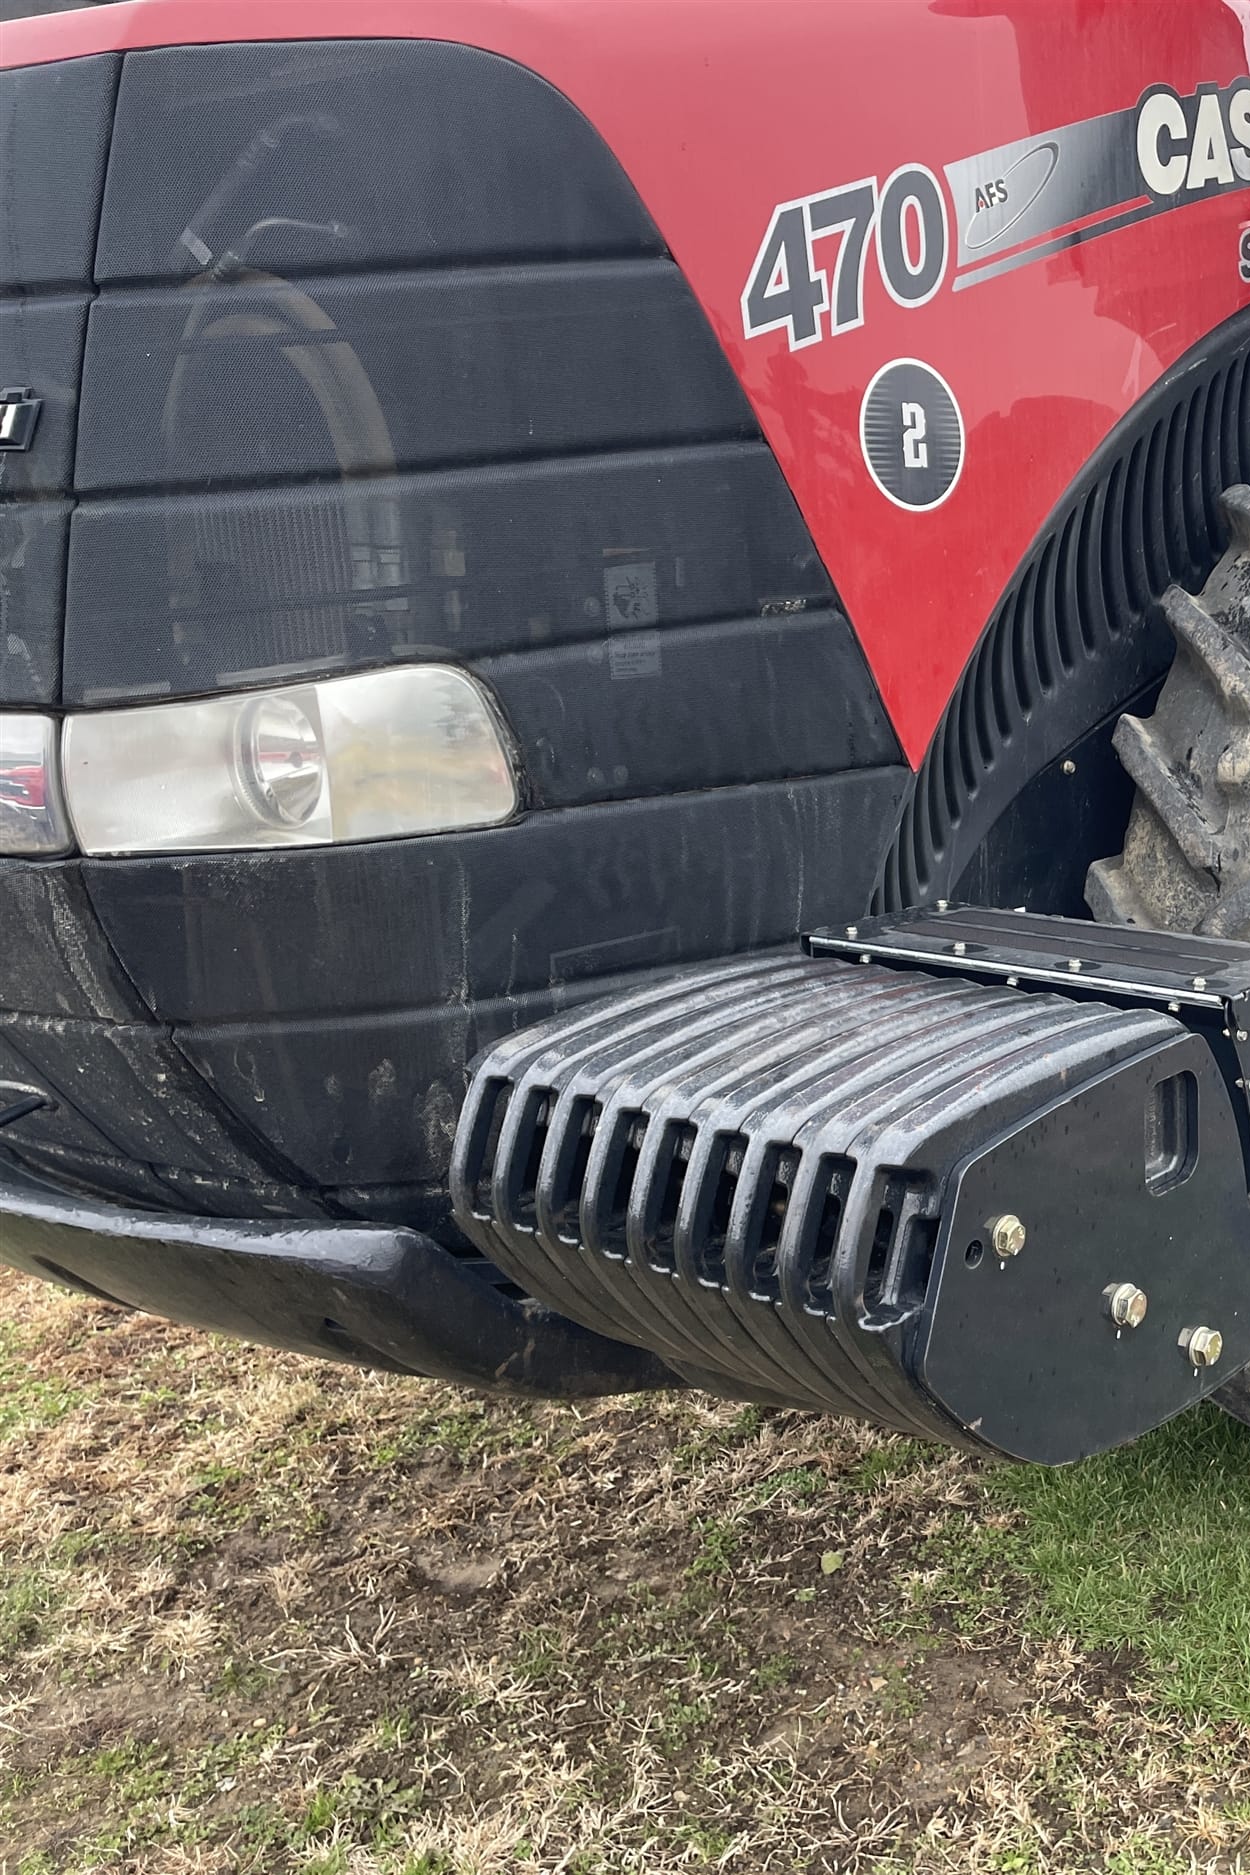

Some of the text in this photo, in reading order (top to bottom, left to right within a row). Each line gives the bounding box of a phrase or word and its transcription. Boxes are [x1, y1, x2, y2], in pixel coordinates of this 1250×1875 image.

[975, 178, 1008, 213] AFS
[740, 163, 948, 352] 470
[902, 402, 928, 468] 2
